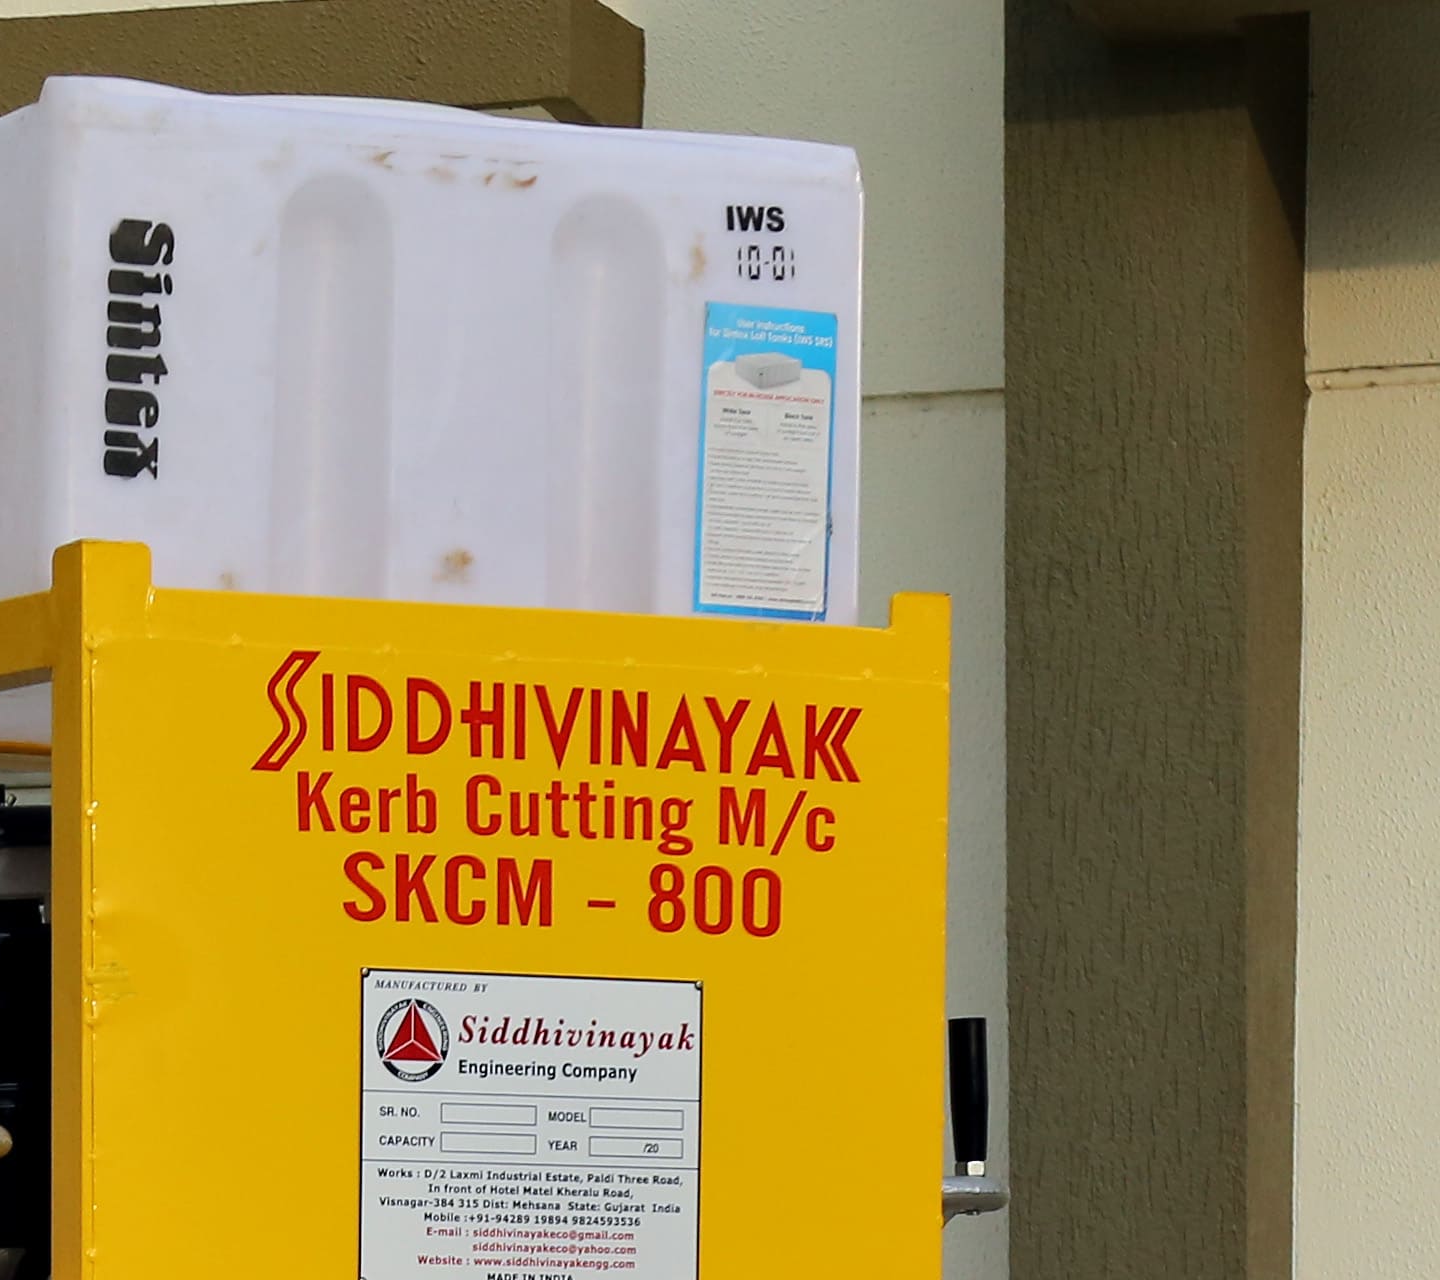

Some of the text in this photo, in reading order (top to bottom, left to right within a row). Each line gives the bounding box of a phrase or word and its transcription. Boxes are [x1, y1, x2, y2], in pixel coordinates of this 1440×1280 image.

[726, 205, 785, 232] IWS
[104, 218, 175, 480] Sintex
[251, 650, 863, 783] SIDDHIVINAYAK
[296, 770, 837, 856] Kerb Cutting M/c
[342, 850, 553, 928] SKCM
[648, 862, 782, 938] 800
[375, 979, 489, 993] MANUFACTURED BY
[458, 1014, 695, 1058] Siddhivinayak
[458, 1059, 638, 1083] Engineering Company
[379, 1106, 420, 1118] SR. NO.
[548, 1111, 587, 1123] MODEL
[379, 1135, 436, 1147] CAPACITY
[548, 1140, 578, 1151] YEAR
[377, 1168, 413, 1178] Works
[424, 1169, 446, 1180] D/2
[450, 1170, 483, 1180] Laxmi
[487, 1171, 542, 1182] Industrial
[545, 1172, 583, 1184] Estate,
[618, 1174, 649, 1184] Three
[653, 1175, 683, 1187] Road,
[428, 1184, 440, 1193] In
[444, 1184, 471, 1194] front
[475, 1185, 487, 1194] of
[490, 1185, 519, 1195] Hotel
[557, 1187, 599, 1197] Kheralu
[603, 1188, 634, 1199] Road,
[379, 1197, 681, 1214] Visnagar-384 315 Dist: Mehsana State: Gujarat India
[424, 1213, 461, 1222] Mobile
[426, 1226, 462, 1236] E-mail
[473, 1228, 634, 1241] siddhivinayakeco@gmail.com
[472, 1242, 637, 1255] siddhivinayakeco@yahoo.com
[417, 1255, 463, 1265] Website
[473, 1256, 636, 1270] www.siddhivinayakengg.com
